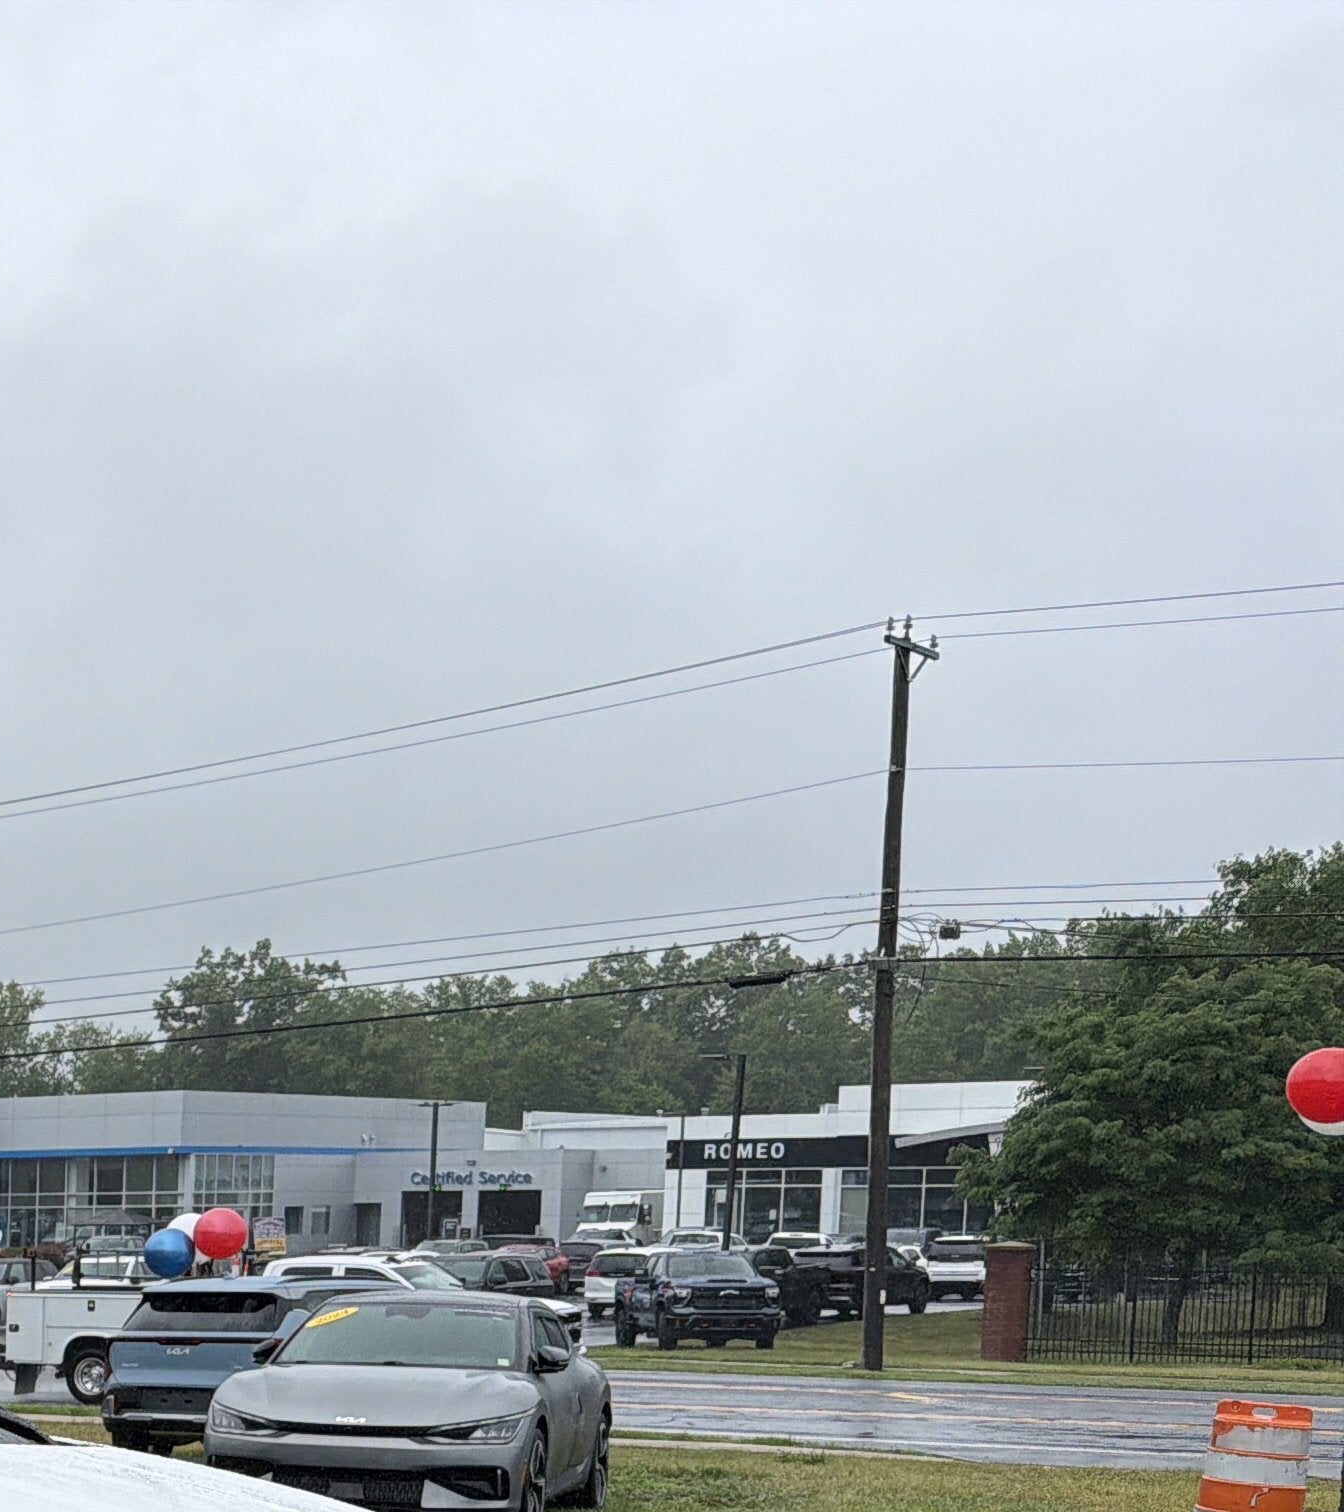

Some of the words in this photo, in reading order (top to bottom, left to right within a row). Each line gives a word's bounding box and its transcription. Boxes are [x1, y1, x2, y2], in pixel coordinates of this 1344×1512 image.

[703, 1141, 785, 1160] ROMEO
[411, 1171, 473, 1186] Cetified
[478, 1170, 533, 1185] Service
[166, 1347, 191, 1355] KIA
